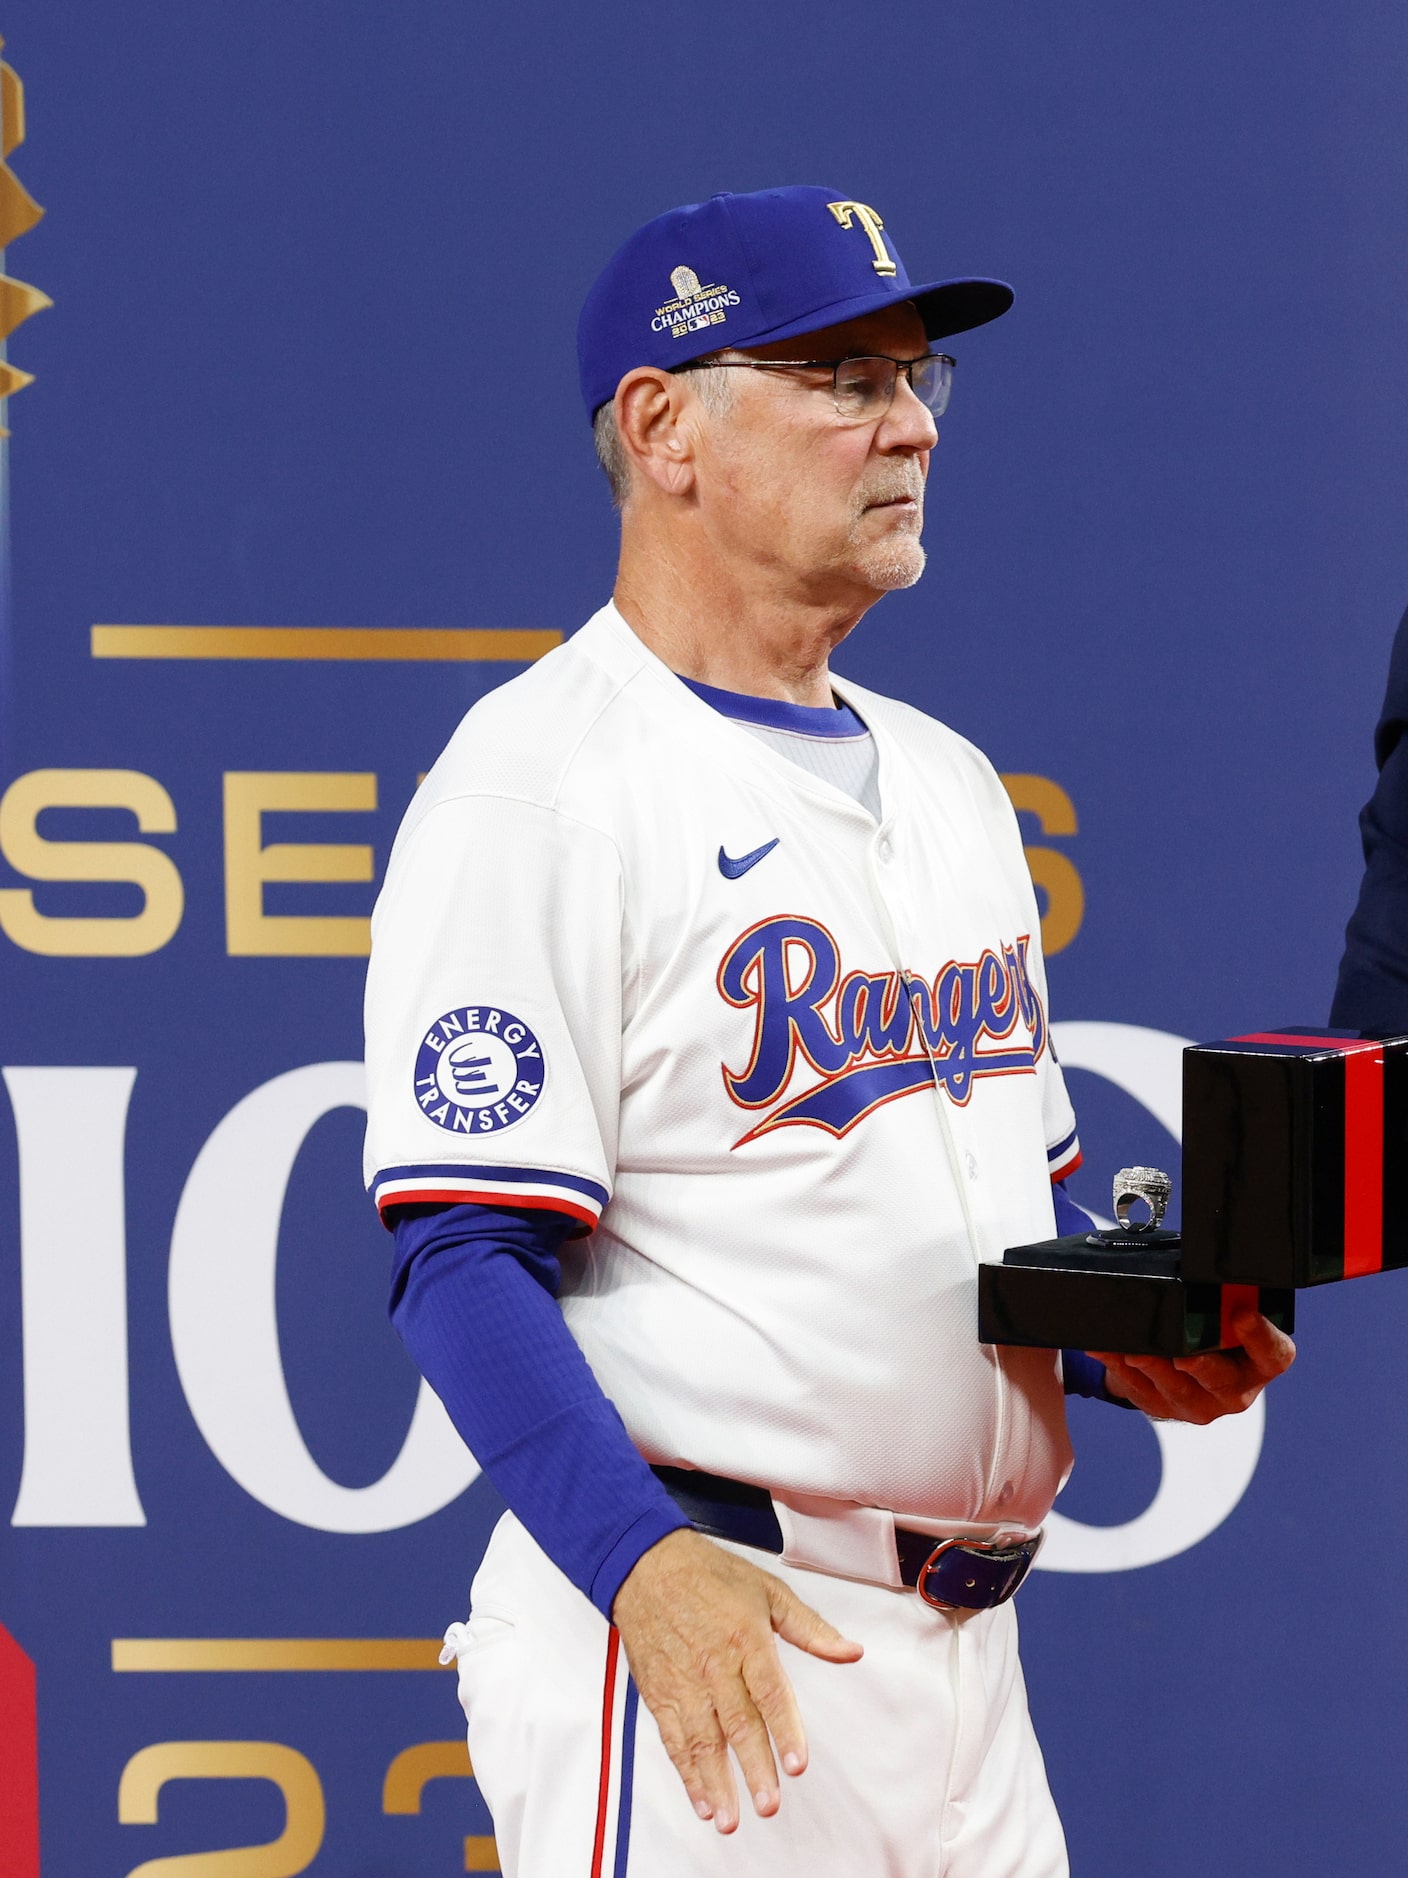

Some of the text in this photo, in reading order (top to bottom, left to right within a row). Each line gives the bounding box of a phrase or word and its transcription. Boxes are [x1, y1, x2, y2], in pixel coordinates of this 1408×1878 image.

[825, 200, 897, 277] T
[651, 290, 741, 332] CHAMPIONS
[655, 285, 728, 316] WORLD SERIES
[424, 1009, 541, 1053] ENERGY
[716, 914, 1047, 1112] Rangers
[416, 1073, 541, 1133] TRANSFER
